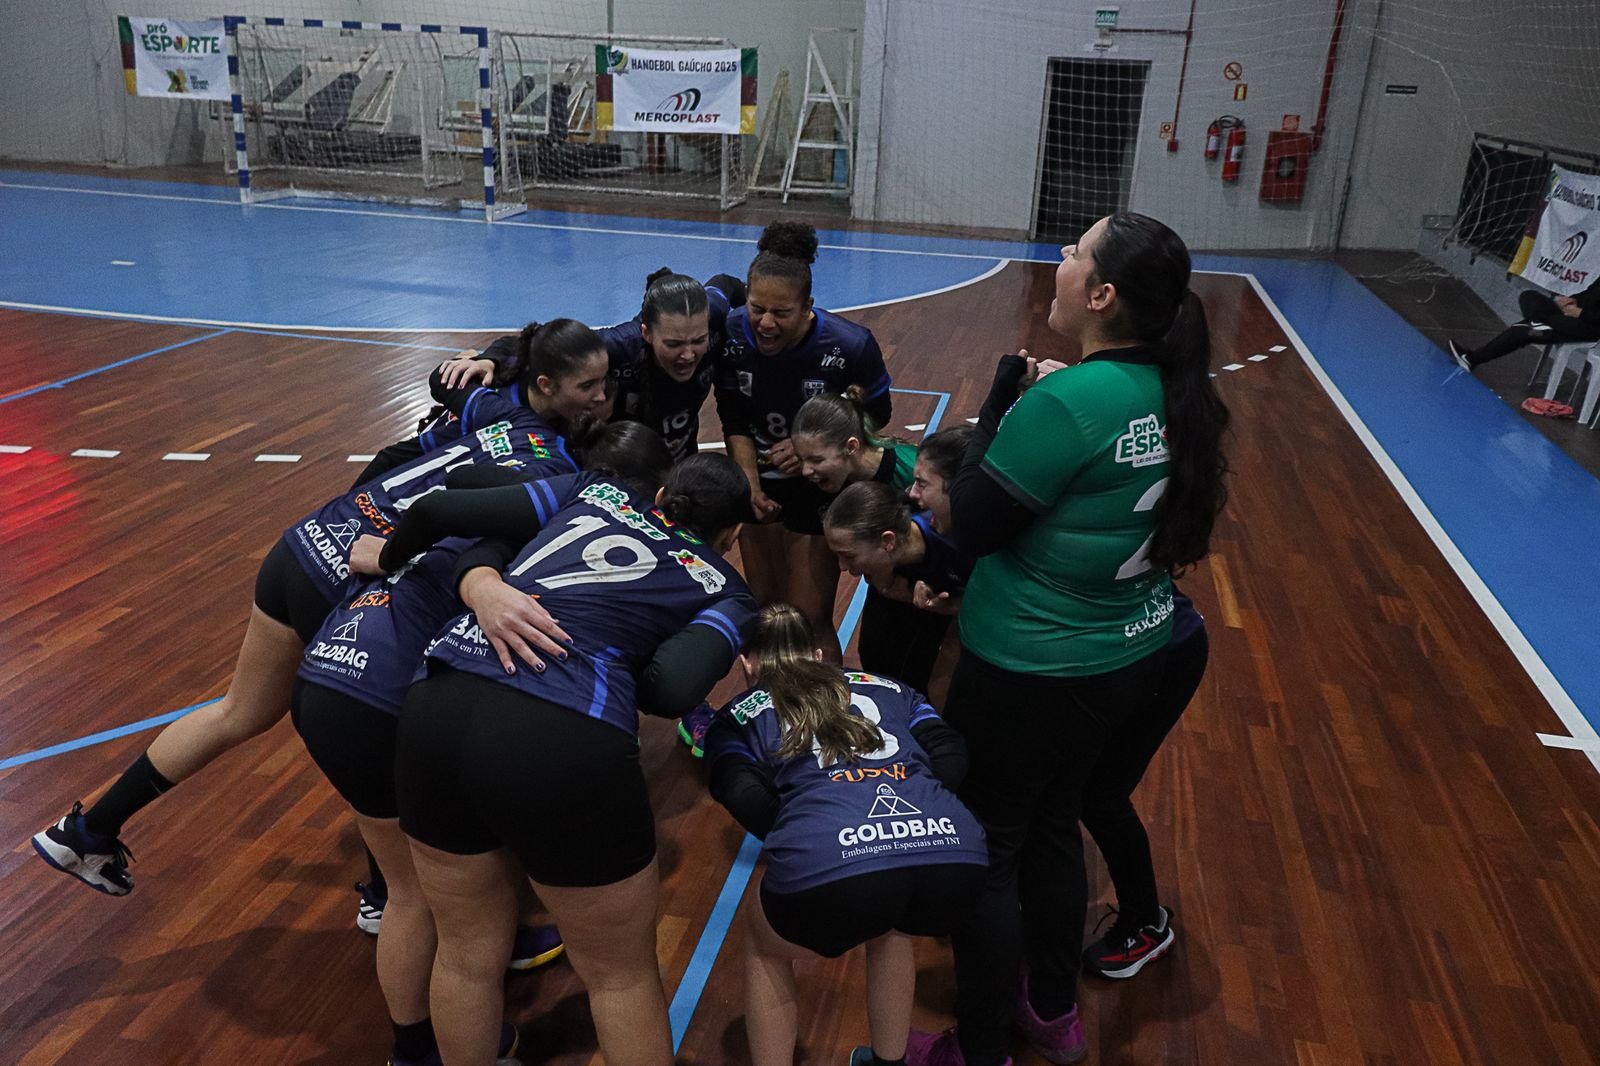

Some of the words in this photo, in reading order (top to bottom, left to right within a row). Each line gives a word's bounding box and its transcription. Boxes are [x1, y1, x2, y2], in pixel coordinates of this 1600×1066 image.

[146, 22, 168, 34] pró
[141, 34, 221, 54] ESPORTE
[631, 58, 676, 72] HANDEBOL
[678, 57, 712, 73] GAÚCHO
[714, 60, 737, 73] 2025
[634, 111, 720, 124] MERCOPLAST
[766, 412, 789, 438] 8
[1133, 418, 1156, 438] pró
[304, 519, 351, 581] GOLDBAG
[510, 515, 658, 590] 19
[472, 646, 490, 658] TNT
[347, 668, 364, 680] TNT
[838, 817, 957, 847] GOLDBAG
[841, 842, 892, 859] Embalagens
[892, 838, 932, 851] Especiais
[932, 838, 945, 846] em
[944, 836, 961, 846] TNT
